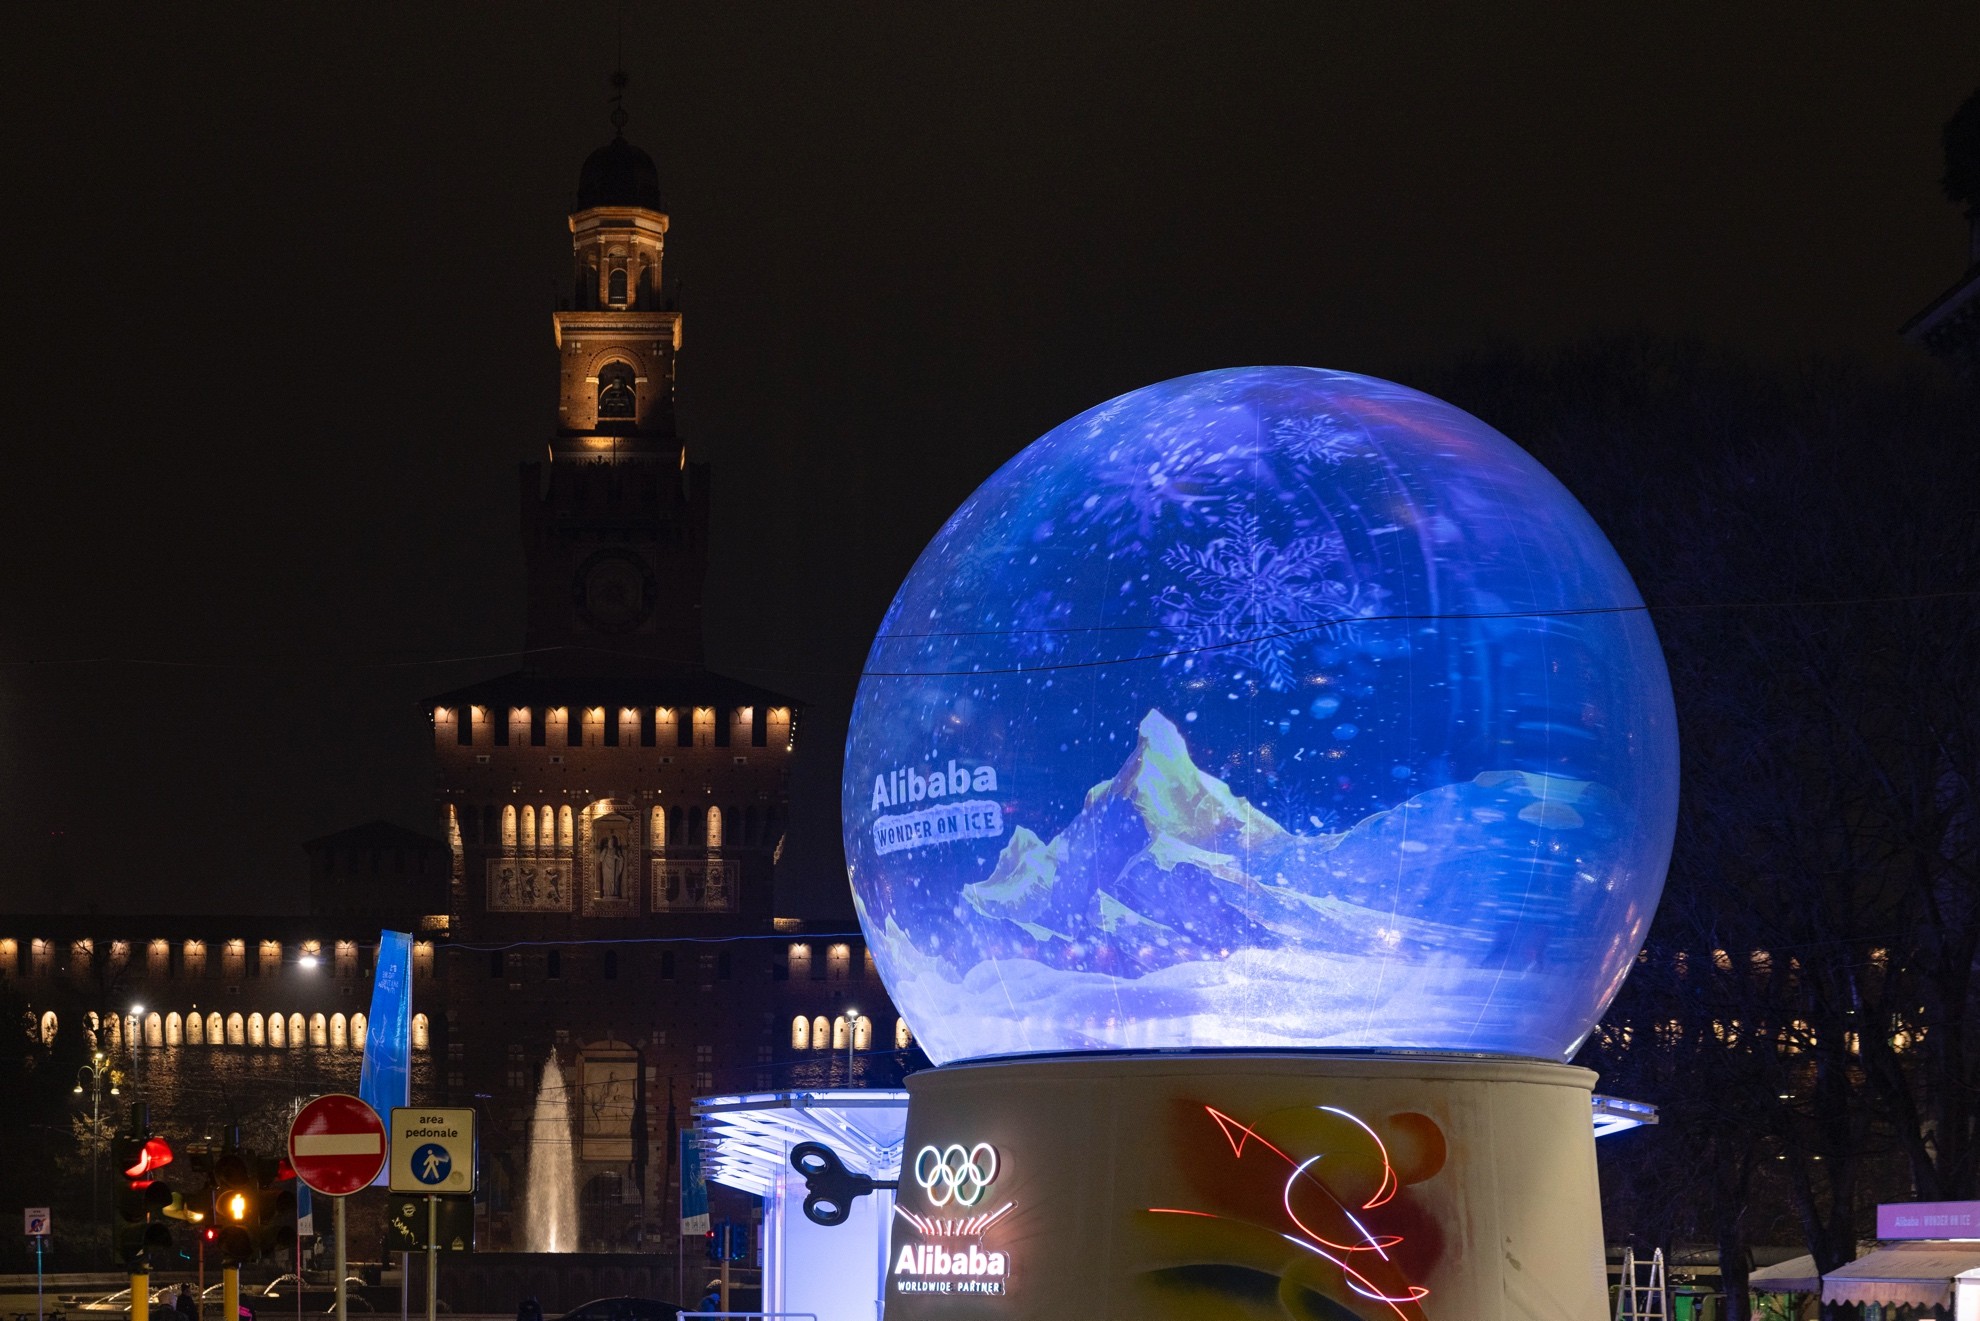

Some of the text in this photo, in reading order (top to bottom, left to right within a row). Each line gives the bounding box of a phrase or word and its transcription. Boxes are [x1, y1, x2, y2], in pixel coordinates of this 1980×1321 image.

[871, 759, 998, 811] Alibaba
[877, 811, 996, 847] WONDER ON ICE
[419, 1116, 444, 1124] area
[405, 1128, 458, 1138] pedonale
[894, 1245, 1005, 1275] Alibaba
[898, 1280, 1000, 1292] WORLDWIDE PARTNER
